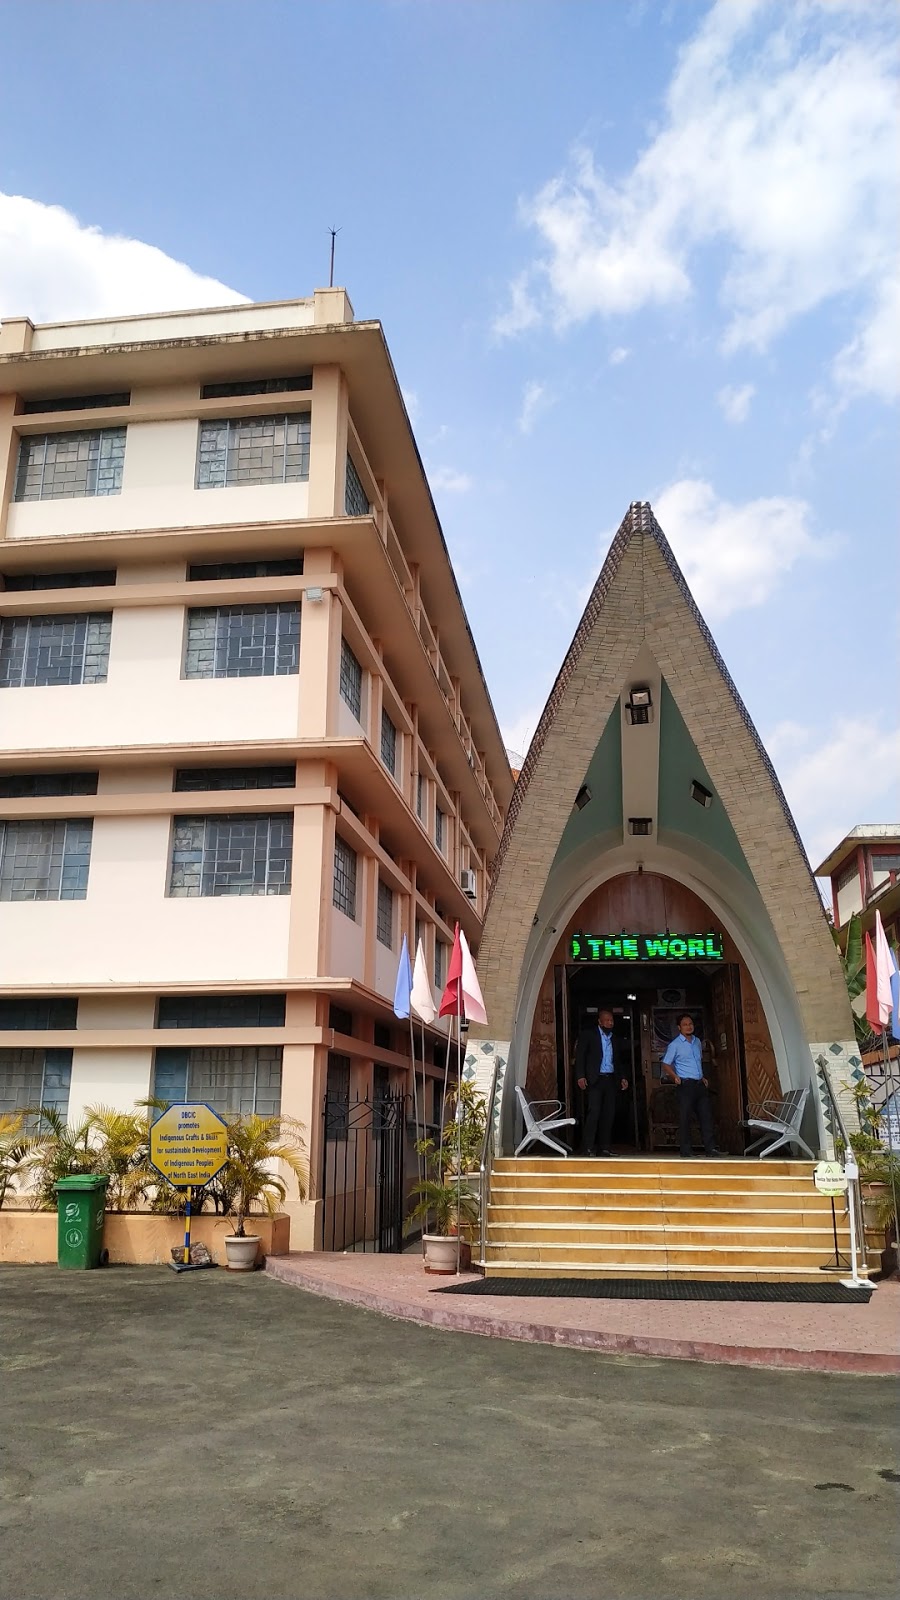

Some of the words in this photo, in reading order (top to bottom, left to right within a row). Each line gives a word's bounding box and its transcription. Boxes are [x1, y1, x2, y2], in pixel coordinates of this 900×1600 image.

[587, 939, 639, 957] THE
[645, 939, 721, 957] WORL
[178, 1122, 200, 1130] promotes
[159, 1134, 184, 1143] Indigenous
[186, 1133, 200, 1141] Crafts
[165, 1146, 191, 1154] sustainable
[192, 1146, 221, 1155] Development
[169, 1159, 195, 1168] Indigenous
[195, 1159, 214, 1168] Peoples
[168, 1171, 173, 1179] of
[173, 1171, 186, 1179] North
[187, 1171, 198, 1179] East
[199, 1171, 211, 1179] India
